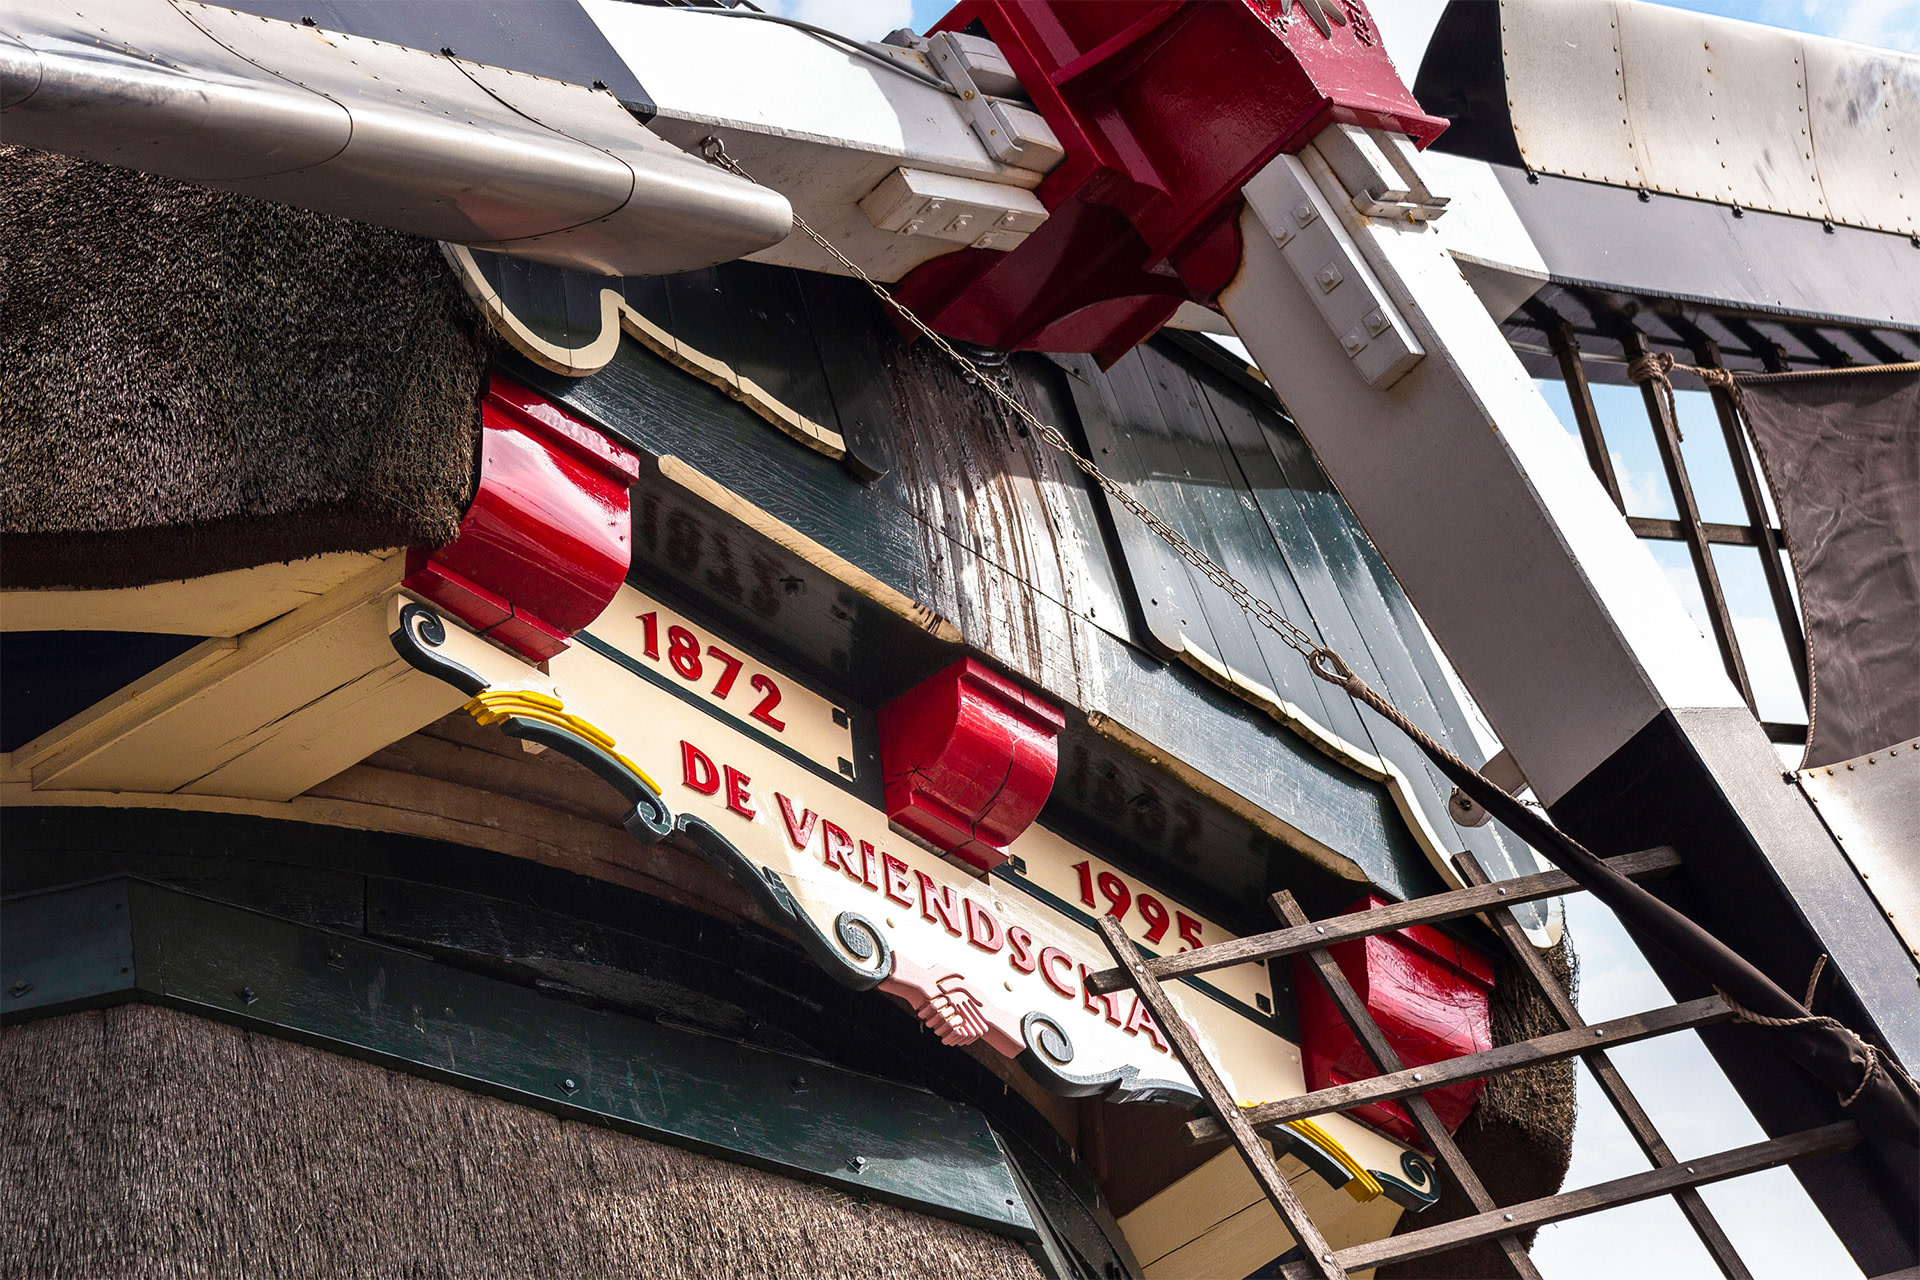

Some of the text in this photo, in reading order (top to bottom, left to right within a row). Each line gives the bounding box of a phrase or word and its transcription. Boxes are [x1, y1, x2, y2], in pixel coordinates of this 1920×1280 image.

[636, 611, 786, 732] 1872
[680, 739, 756, 821] DE
[774, 791, 1200, 1061] VRIENDSCHA
[1071, 860, 1203, 953] 1995
